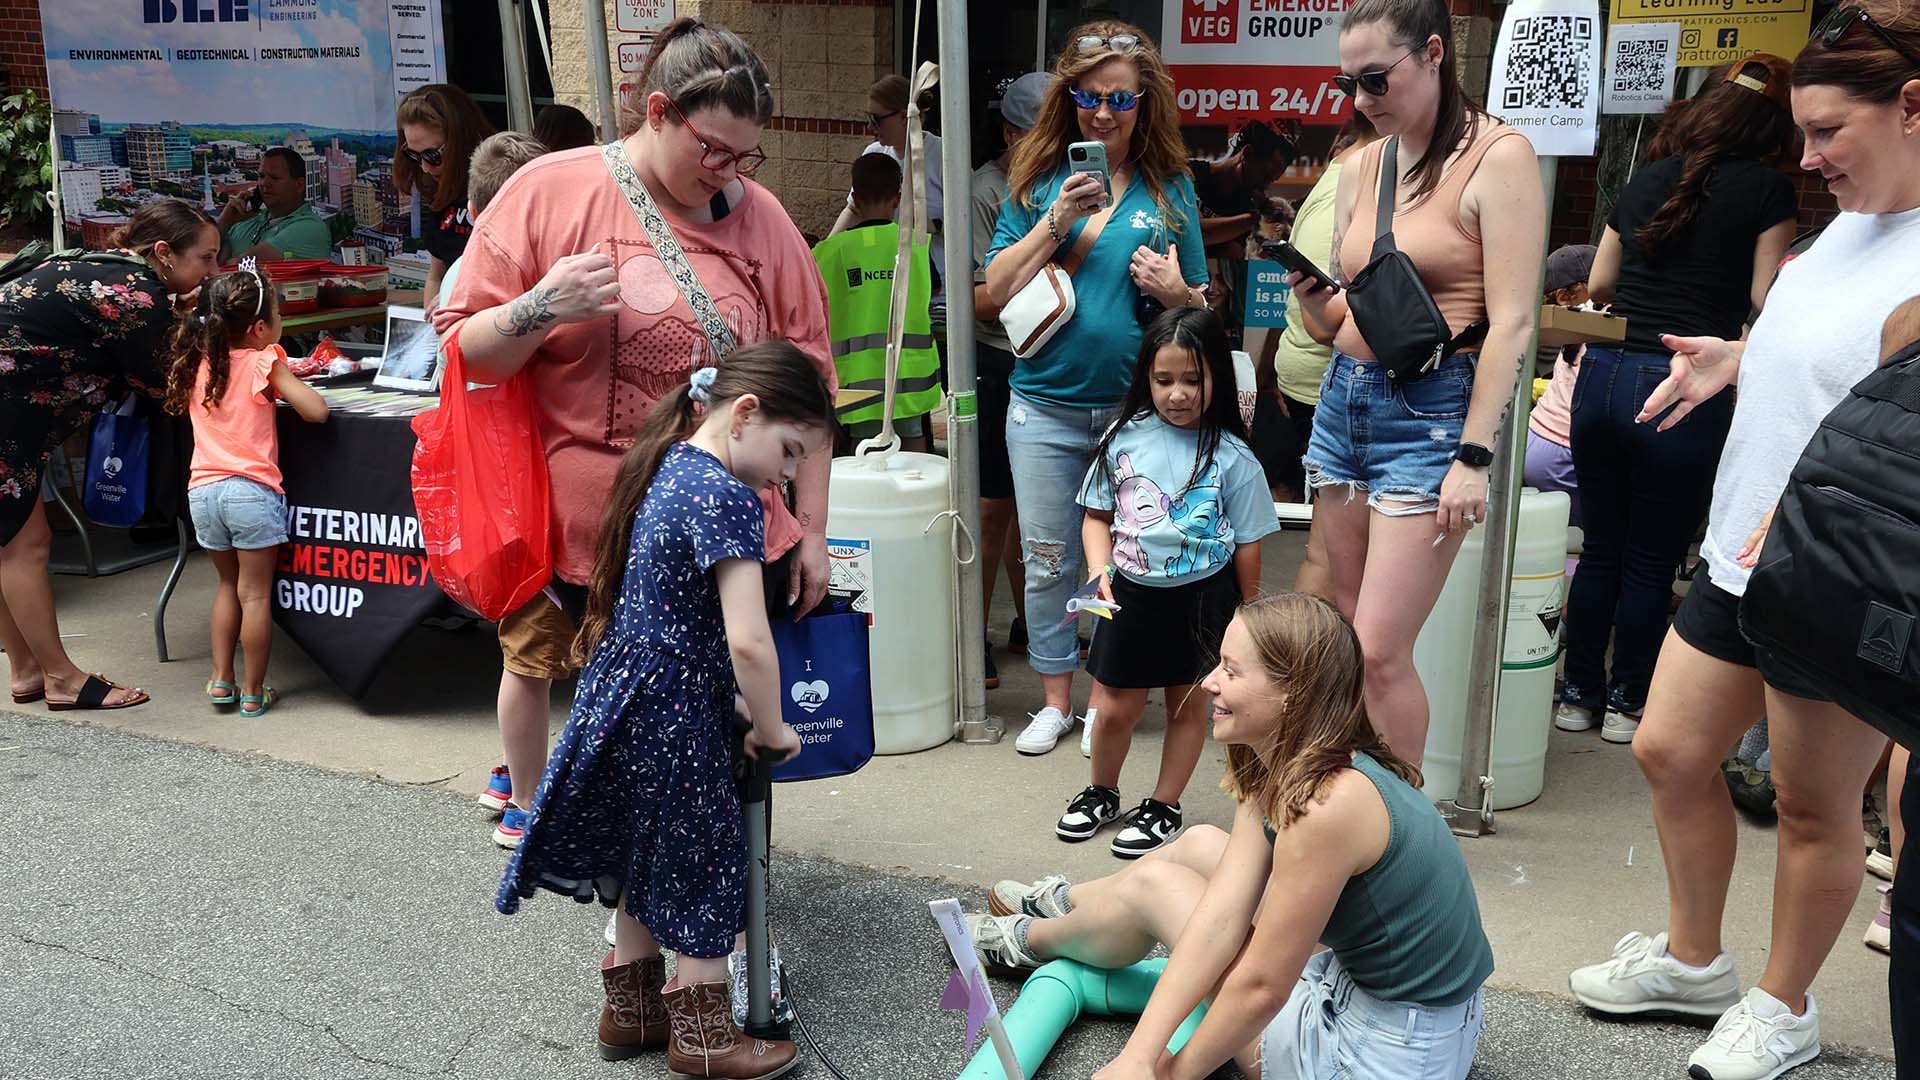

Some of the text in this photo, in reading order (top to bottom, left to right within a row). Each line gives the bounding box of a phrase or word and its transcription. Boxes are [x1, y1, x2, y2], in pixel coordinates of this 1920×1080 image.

[626, 0, 666, 8] LOADING
[1249, 0, 1350, 12] EMERGE
[270, 11, 317, 21] ENGINEERING
[633, 8, 659, 18] ZONE
[1188, 16, 1231, 37] VEG
[69, 46, 360, 61] ENVIRONMENTAL GEOTECHNICAL CONSTRUCTION MATERIALS
[622, 53, 634, 63] 30
[1177, 82, 1346, 118] open 24/7
[1550, 115, 1584, 128] Camp
[1255, 288, 1270, 303] is
[95, 481, 127, 494] Greenville
[101, 492, 121, 502] Water
[833, 547, 855, 556] UNX
[278, 543, 431, 587] EMERGENCY
[276, 578, 364, 618] GROUP
[804, 659, 812, 671] I
